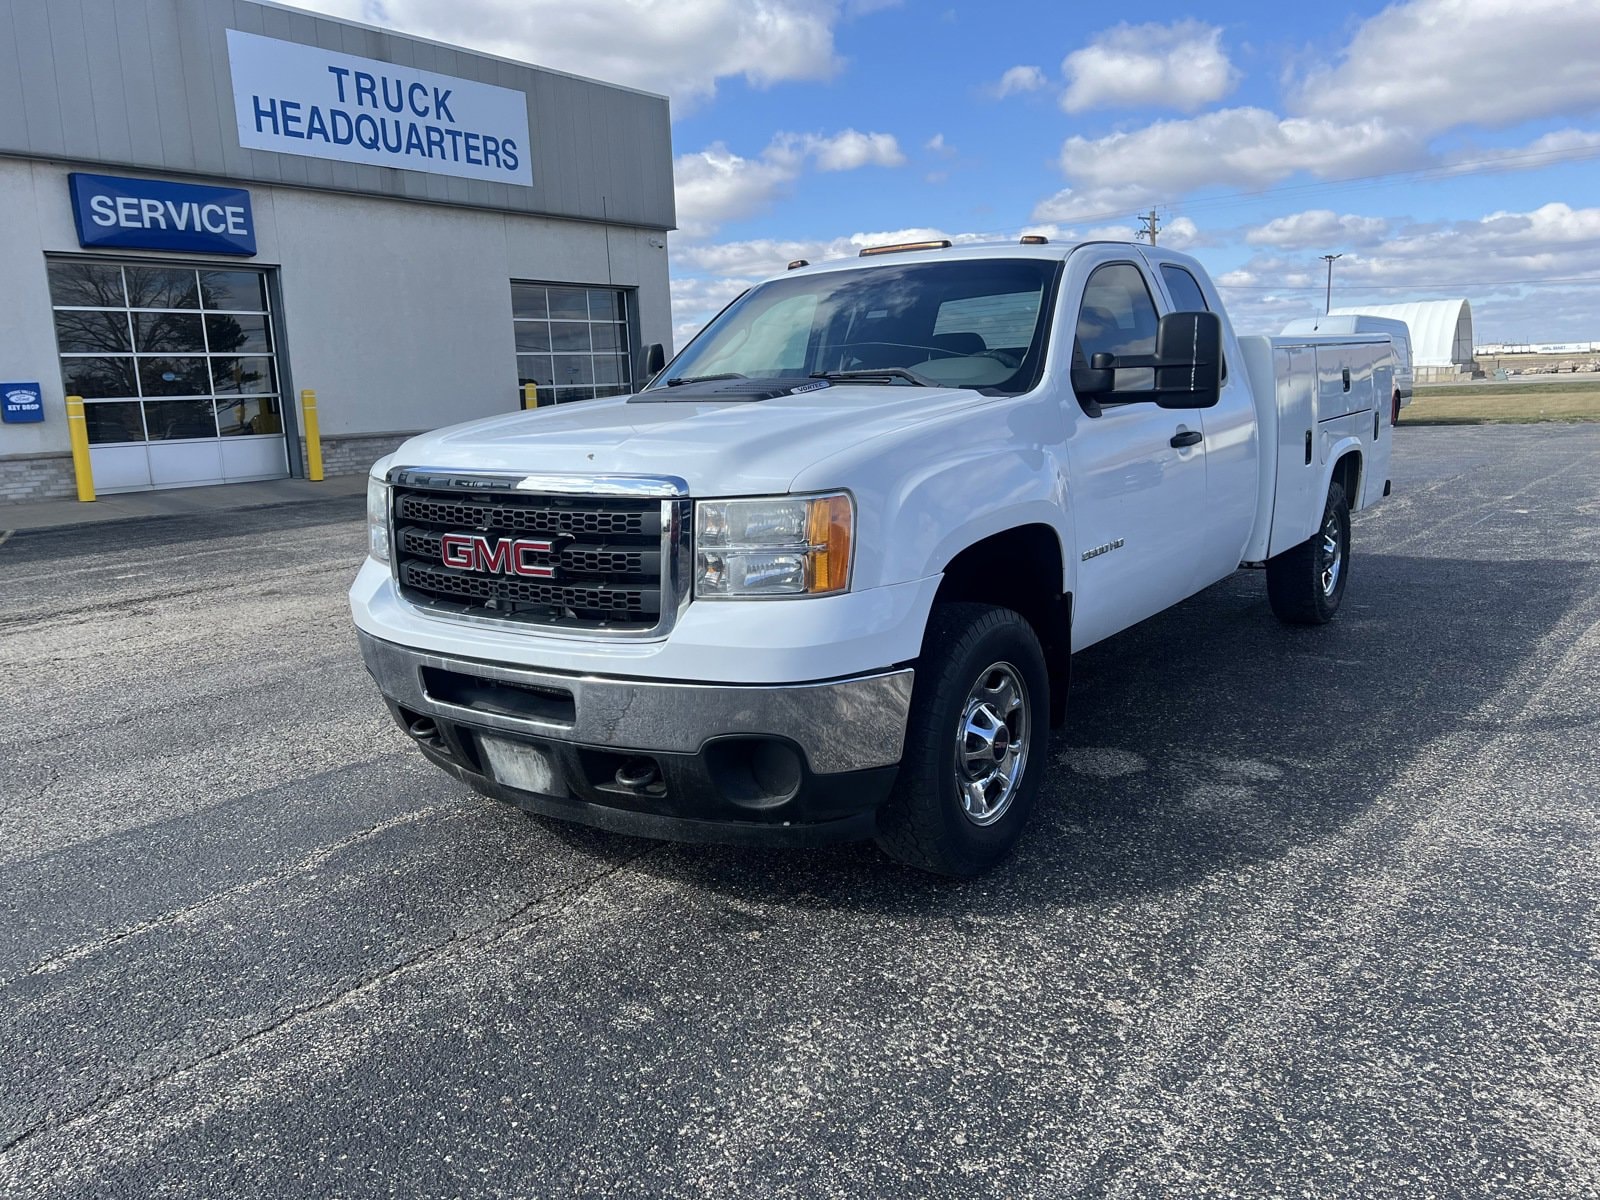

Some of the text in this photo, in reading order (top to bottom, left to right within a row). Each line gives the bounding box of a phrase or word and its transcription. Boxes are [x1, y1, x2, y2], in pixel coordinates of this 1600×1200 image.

[328, 66, 456, 123] TRUCK
[252, 95, 519, 171] HEADQUARTERS
[90, 195, 248, 235] SERVICE
[441, 533, 556, 578] GMC
